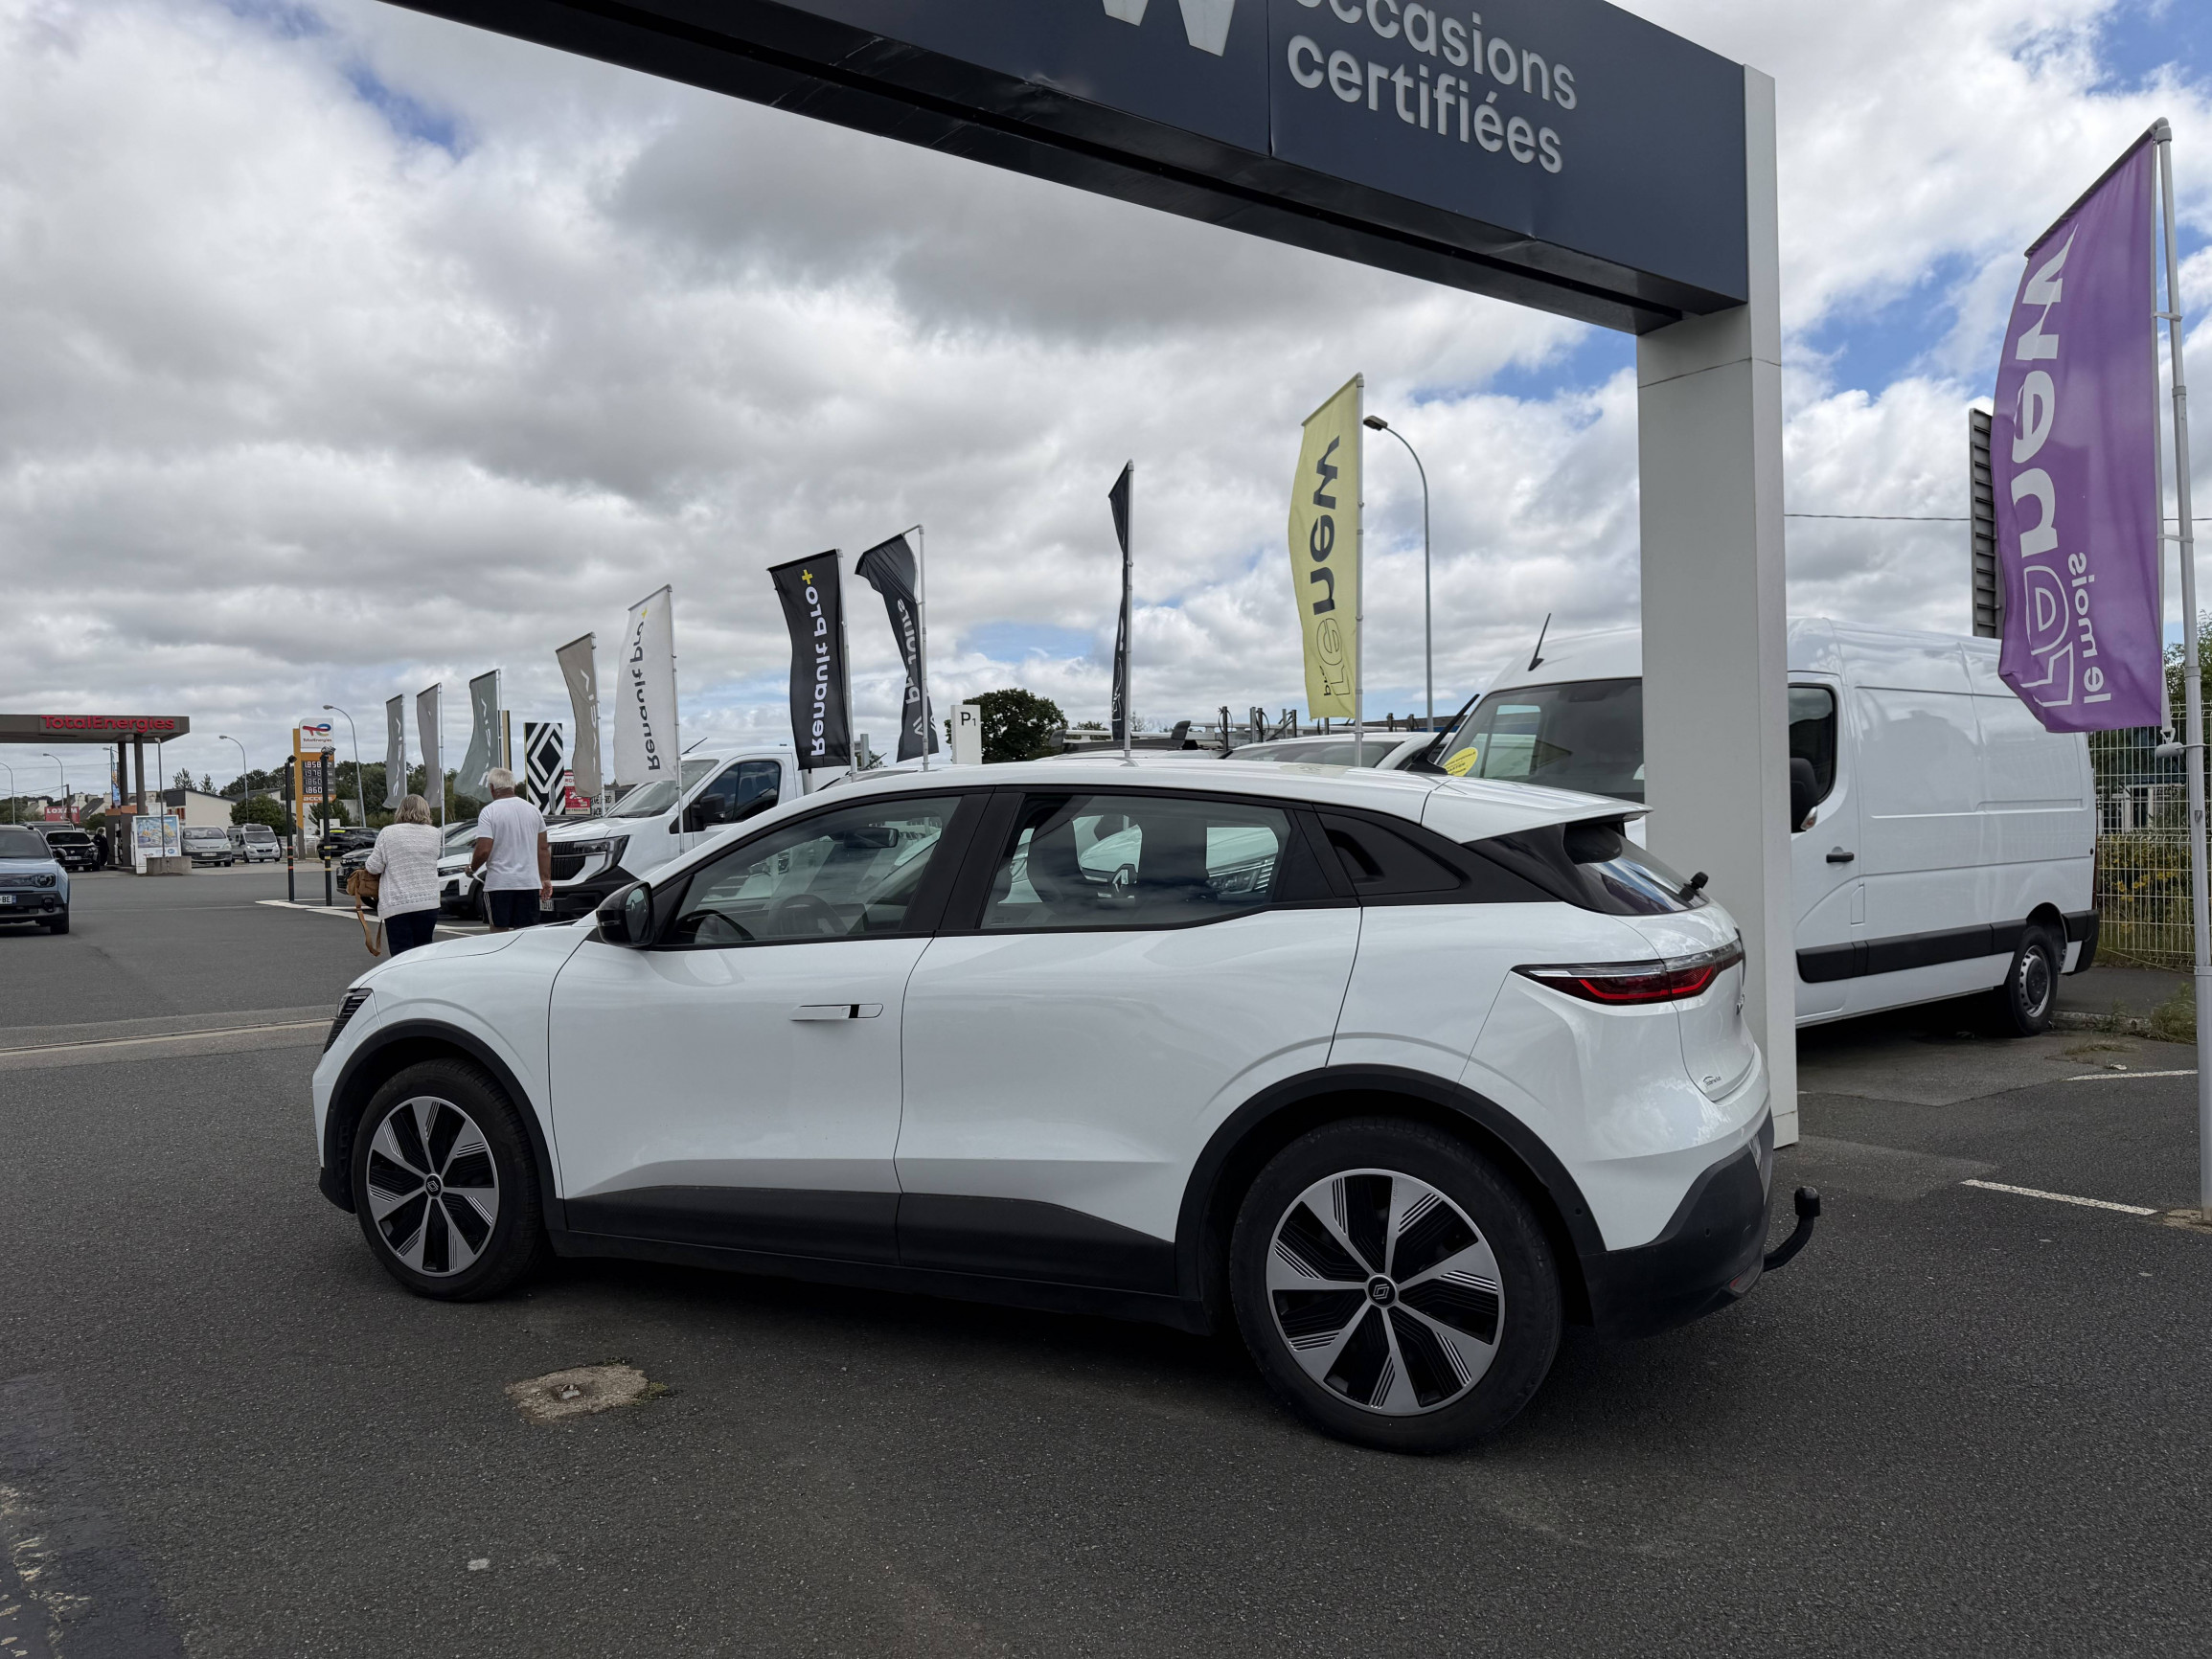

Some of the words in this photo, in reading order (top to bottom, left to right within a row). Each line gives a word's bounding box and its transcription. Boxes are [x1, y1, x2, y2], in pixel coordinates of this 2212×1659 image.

[1288, 34, 1563, 173] certifiées
[1295, 0, 1578, 110] casions
[40, 716, 174, 733] TotalEnergies
